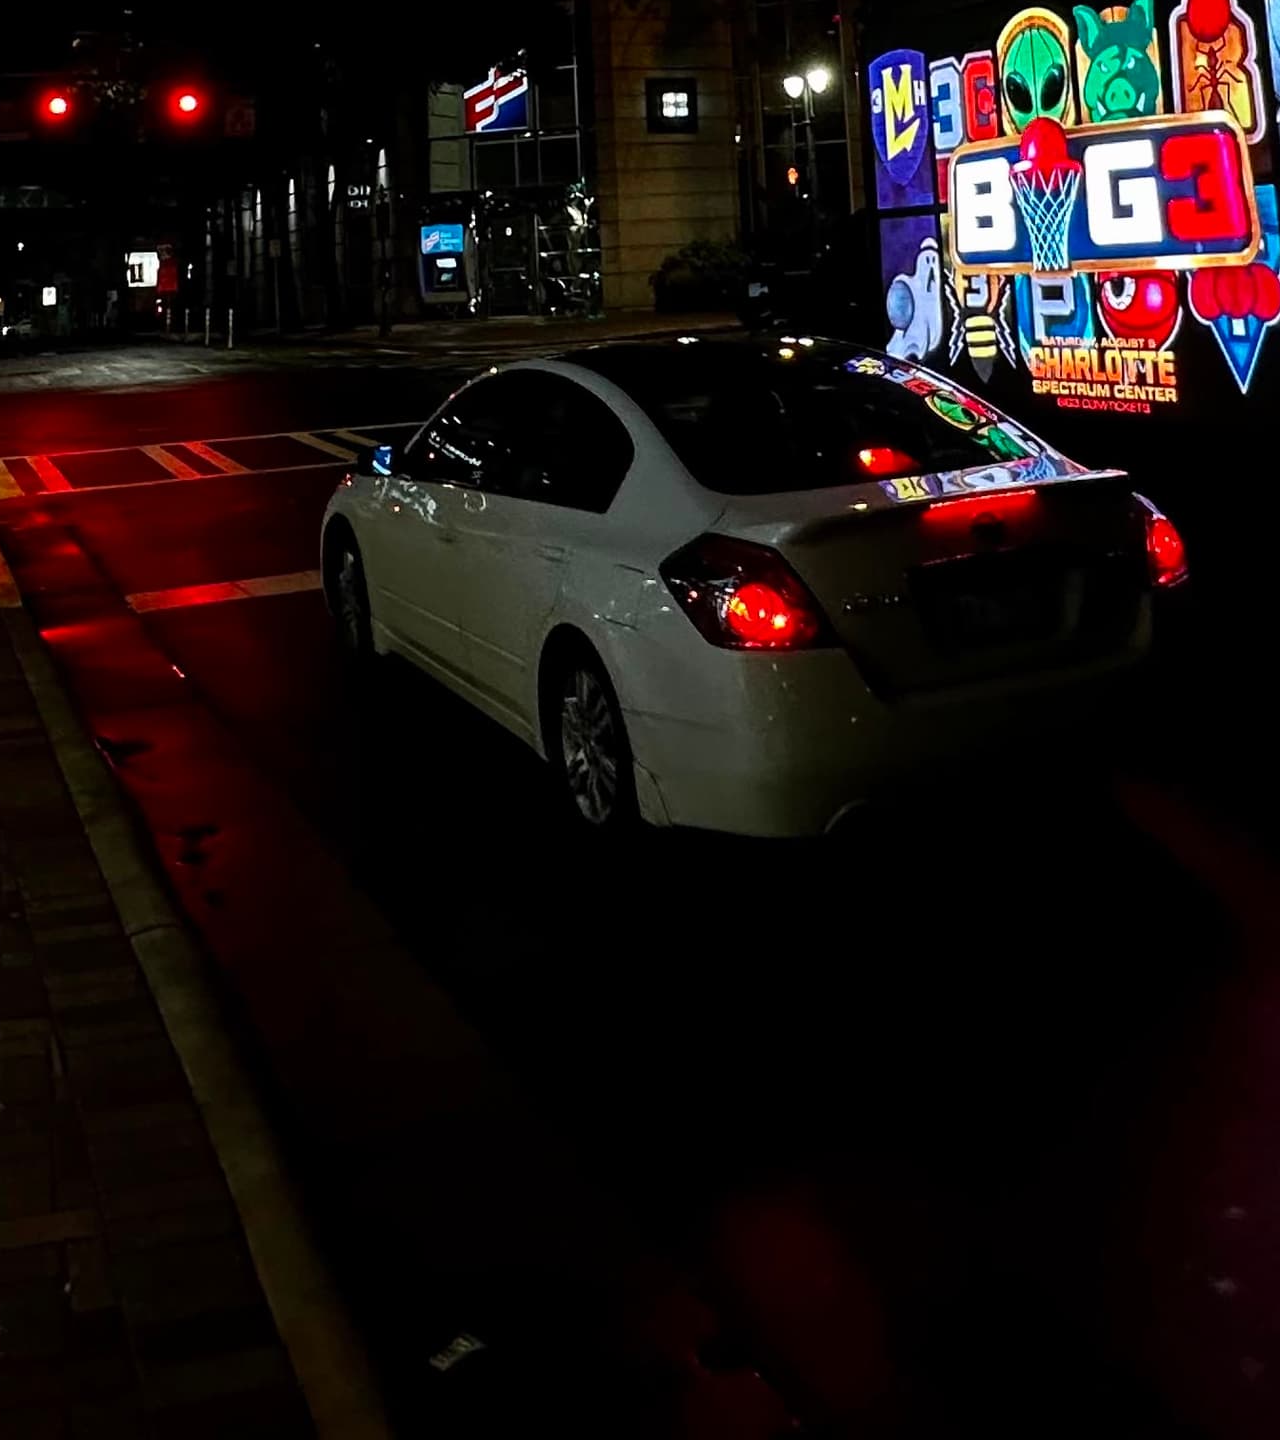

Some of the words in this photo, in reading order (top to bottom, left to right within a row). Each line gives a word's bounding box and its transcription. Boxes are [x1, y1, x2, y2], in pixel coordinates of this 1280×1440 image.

[1031, 347, 1177, 386] CHARLOTTE
[1032, 380, 1111, 397] SPECTRUM
[1114, 385, 1178, 403] CENTER
